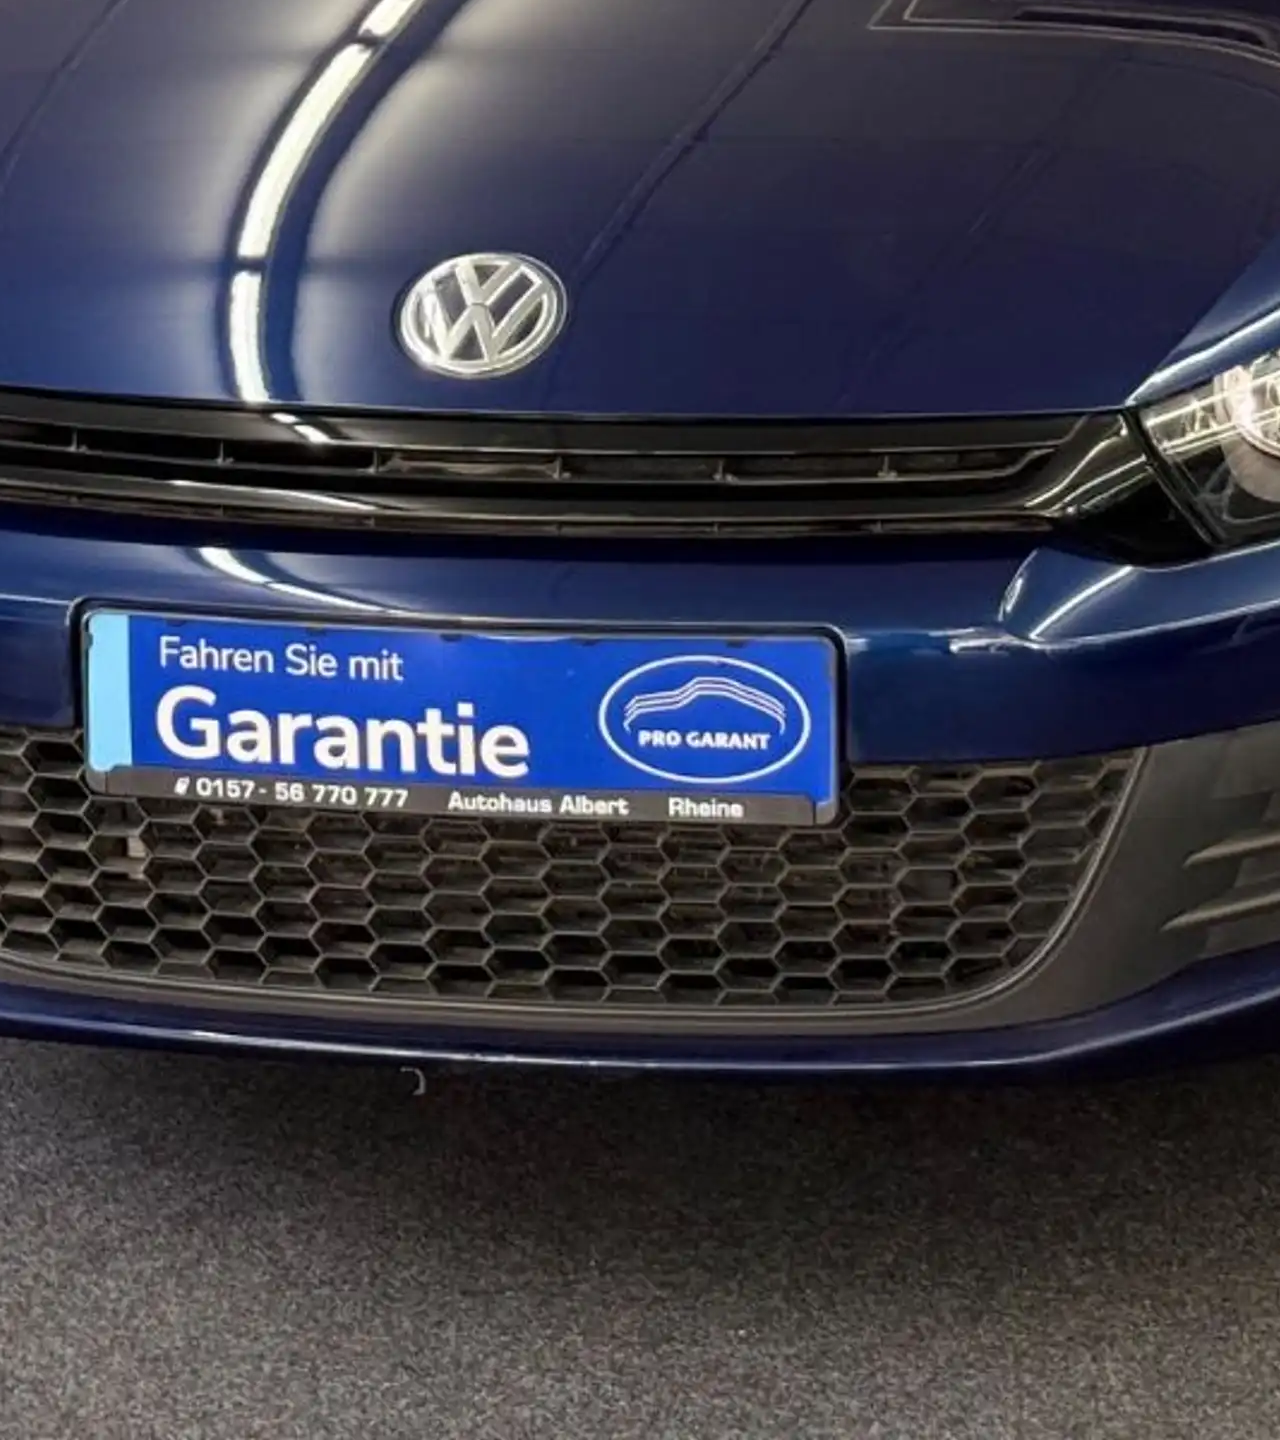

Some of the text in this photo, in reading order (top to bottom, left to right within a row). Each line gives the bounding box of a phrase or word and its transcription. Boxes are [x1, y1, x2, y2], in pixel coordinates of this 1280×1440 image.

[159, 635, 404, 681] Fahren Sie mit
[155, 684, 530, 778] Garantie
[638, 729, 771, 750] PRO GARANT
[275, 782, 305, 802] 56
[312, 785, 358, 805] 770
[364, 787, 409, 807] 777
[447, 790, 552, 814] Autohaus
[559, 795, 630, 816] Albert
[668, 797, 743, 818] Rheine
